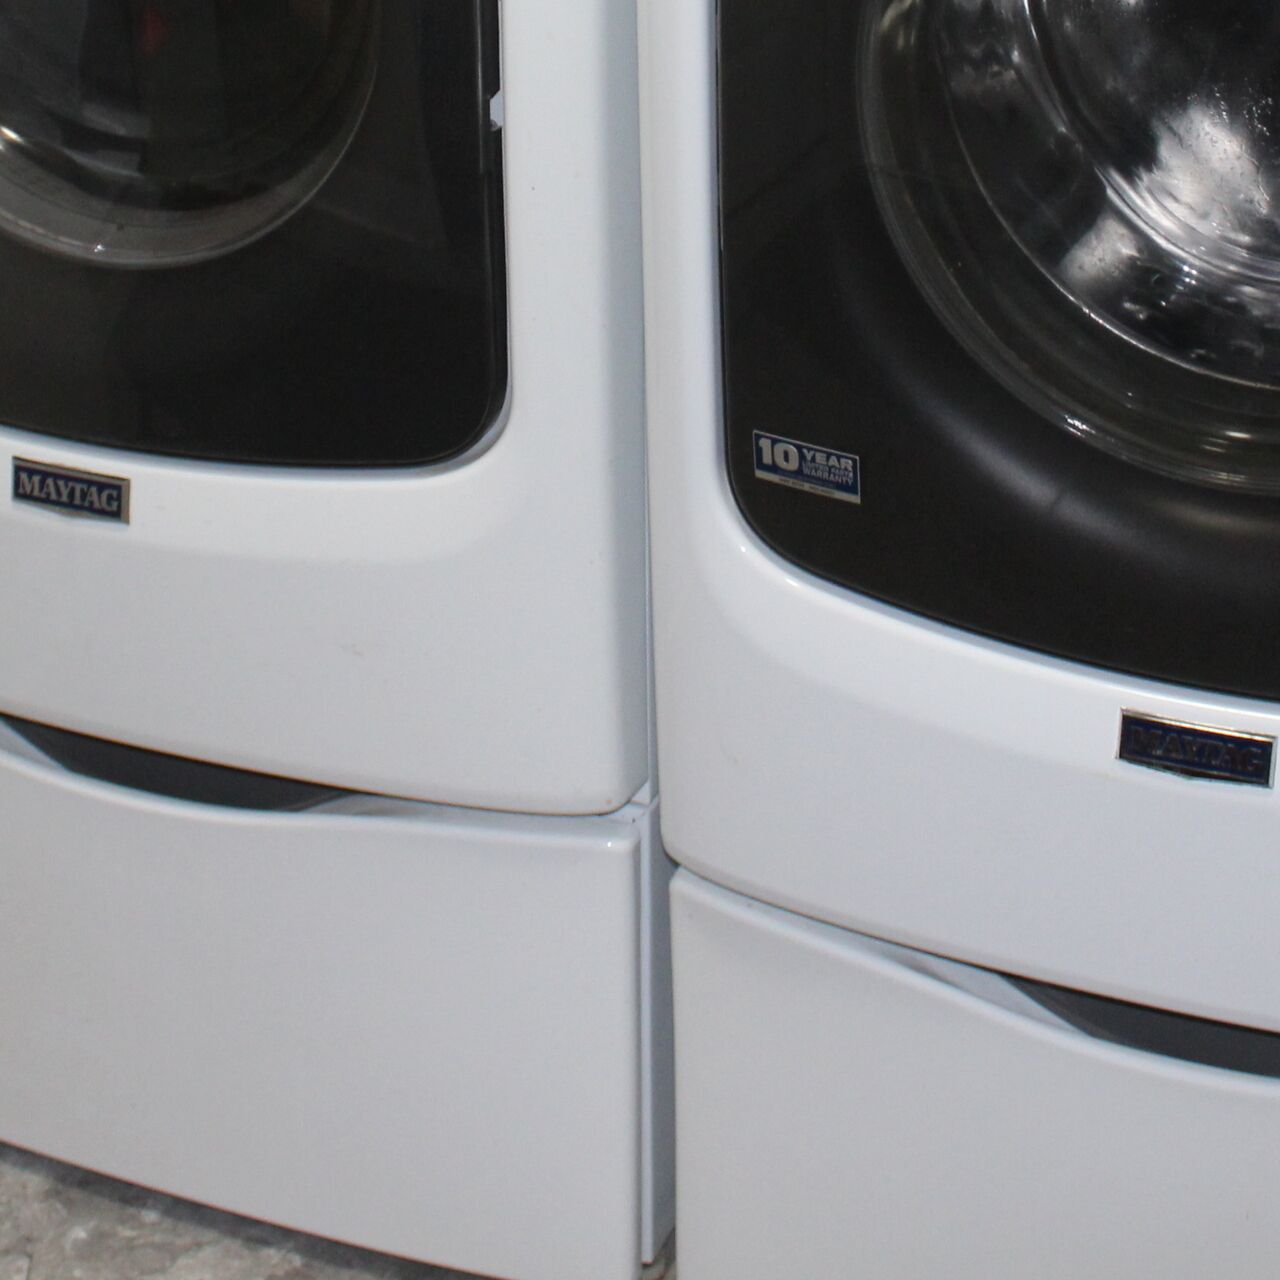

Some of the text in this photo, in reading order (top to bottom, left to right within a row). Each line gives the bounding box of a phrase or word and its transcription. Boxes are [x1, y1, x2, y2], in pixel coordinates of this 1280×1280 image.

[759, 437, 854, 472] 10 YEAR
[17, 471, 120, 512] MAYTAG
[803, 467, 854, 486] WARRANTY
